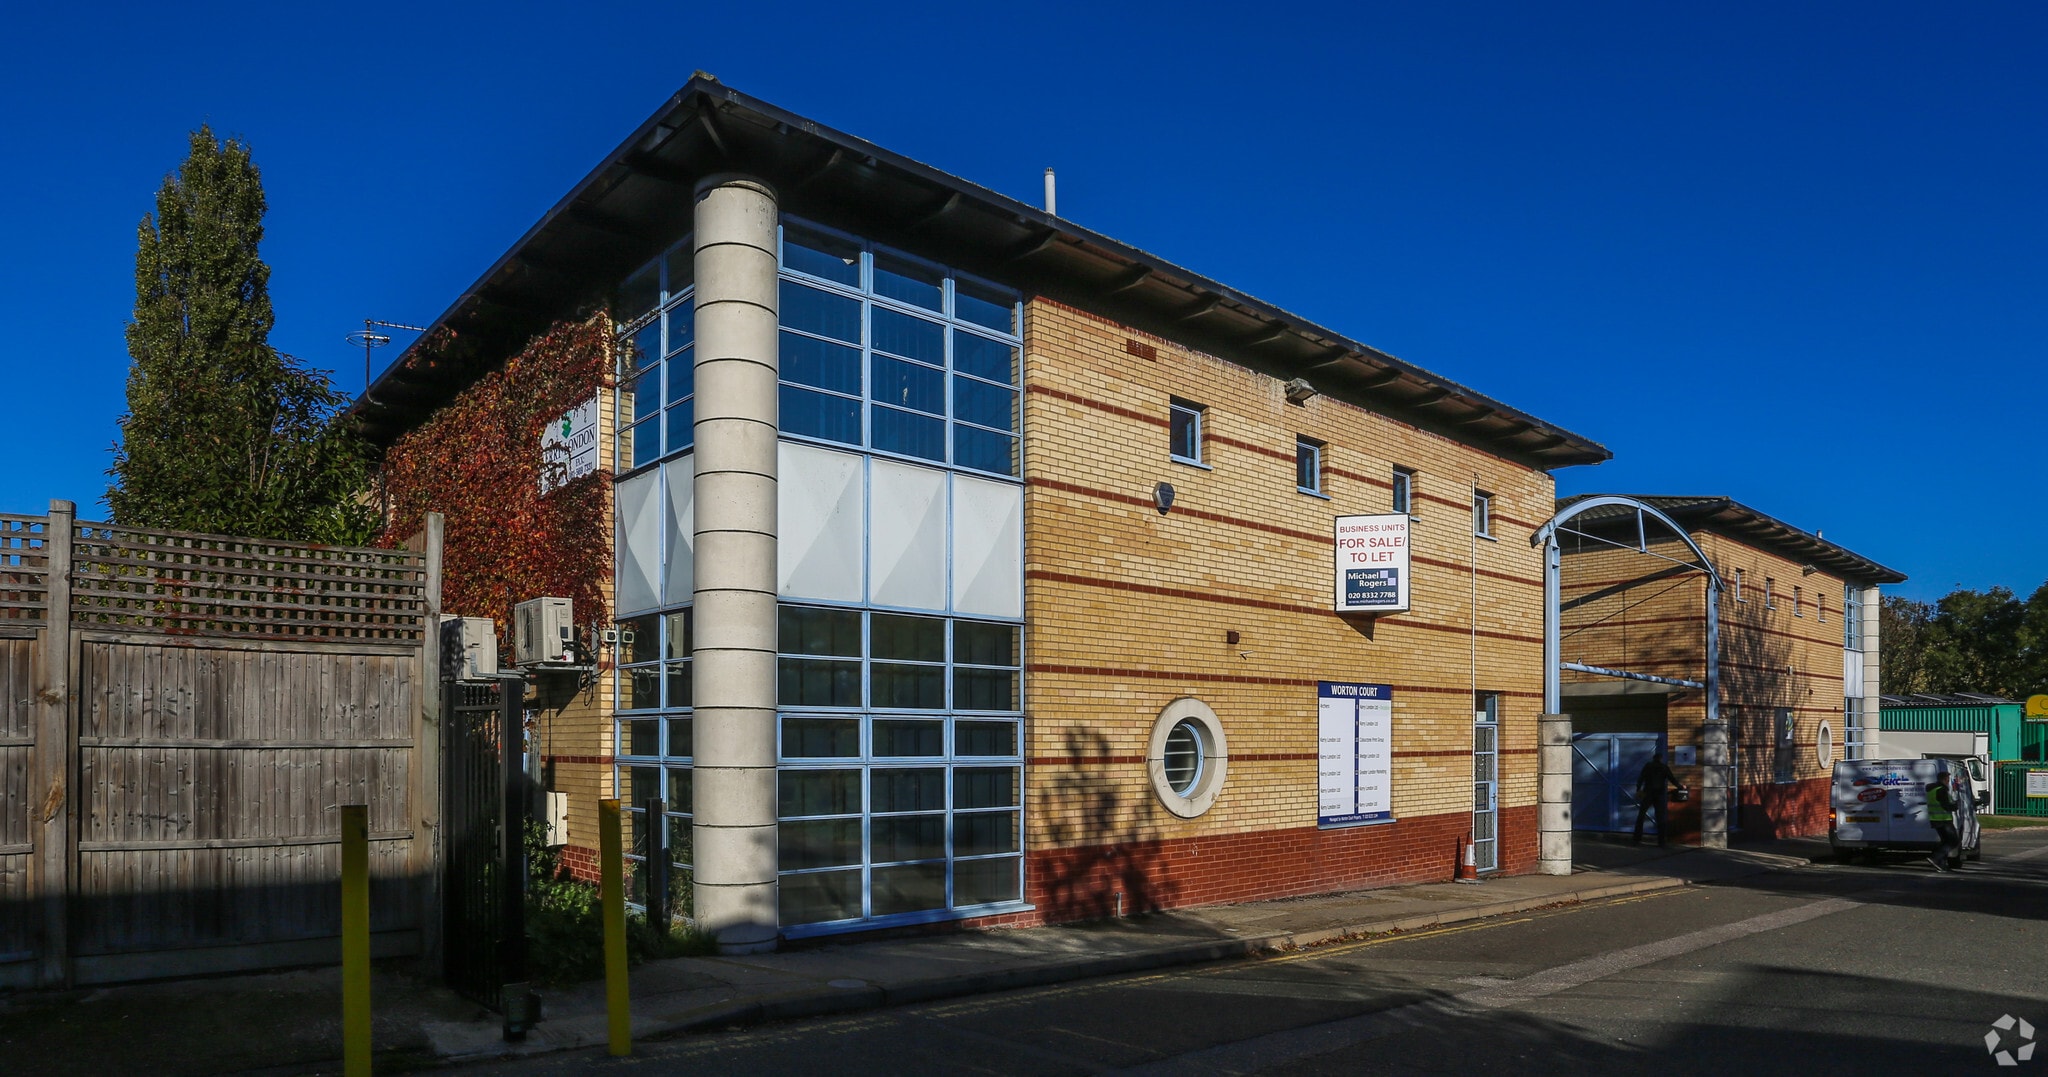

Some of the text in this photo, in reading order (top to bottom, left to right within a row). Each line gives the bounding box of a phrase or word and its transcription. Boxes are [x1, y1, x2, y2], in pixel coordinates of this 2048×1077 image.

[1339, 523, 1405, 534] BUSINESS UNITS
[1339, 537, 1406, 549] FOR SALE/
[1350, 551, 1394, 563] TO LET
[1348, 572, 1379, 580] Michael
[1359, 580, 1387, 588] Rogers
[1331, 685, 1378, 697] WORTON COURT
[1882, 778, 1901, 786] GKC
